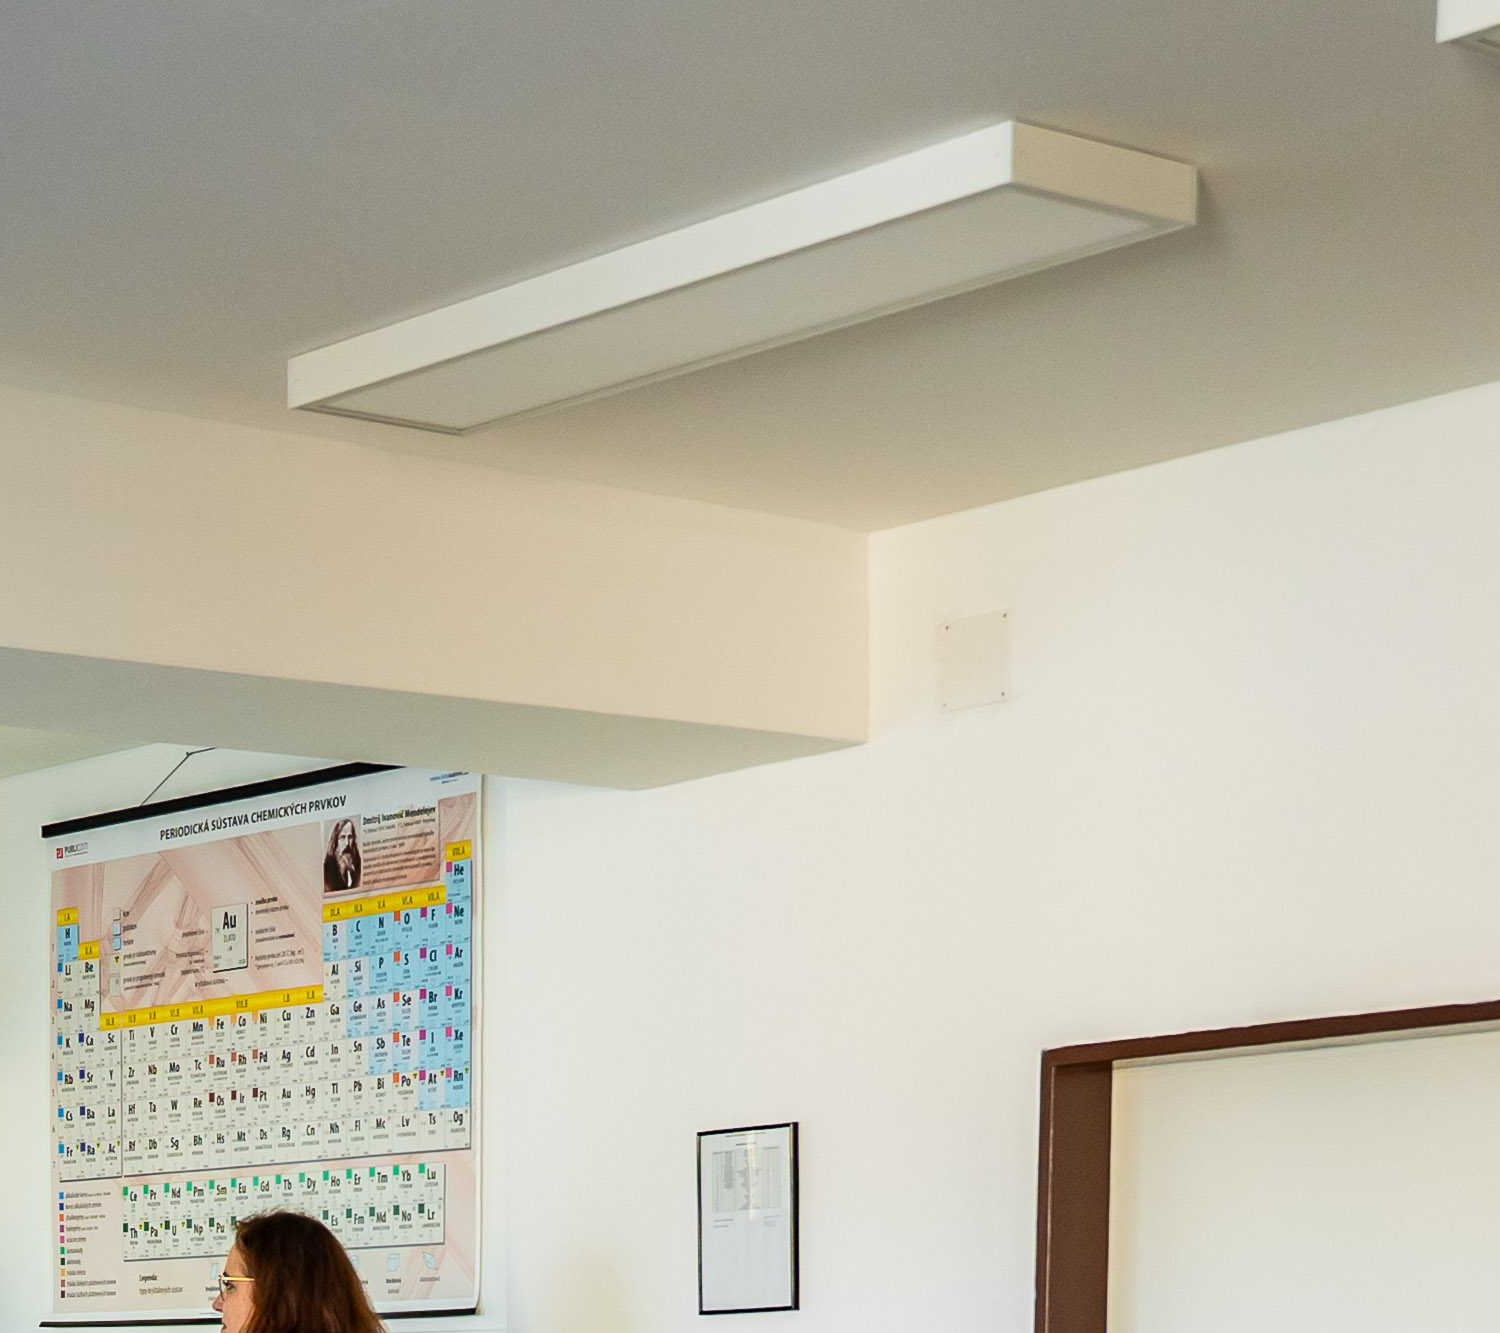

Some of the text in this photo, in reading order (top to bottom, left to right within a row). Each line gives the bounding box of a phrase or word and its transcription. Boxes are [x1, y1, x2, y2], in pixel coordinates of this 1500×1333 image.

[160, 795, 347, 840] PERIODICKÁ SÚSTAVA CHEMICKÝCH PRVKOV
[454, 864, 464, 876] He
[431, 909, 436, 921] F
[454, 905, 464, 917] Ne
[223, 912, 237, 929] Au
[378, 916, 384, 929] N
[404, 912, 410, 925] O
[332, 924, 338, 936] B
[356, 920, 361, 933] C
[65, 928, 71, 939] H
[430, 950, 437, 962] Cl
[454, 946, 463, 959] Ar
[379, 957, 384, 969] P
[404, 953, 409, 966] S
[65, 965, 71, 976] Li
[85, 962, 94, 973] Be
[331, 964, 339, 976] Al
[354, 960, 361, 973] Si
[428, 991, 438, 1003] Br
[454, 988, 463, 1000] Kr
[84, 999, 95, 1012] Mg
[376, 998, 386, 1009] As
[402, 994, 412, 1006] Se
[63, 1001, 73, 1012] Na
[330, 1004, 340, 1015] Ga
[353, 1001, 362, 1012] Ge
[260, 1013, 267, 1024] Ni
[282, 1010, 291, 1021] Cu
[305, 1007, 315, 1019] Zn
[192, 1022, 203, 1032] Mn
[216, 1018, 225, 1030] Fe
[238, 1016, 246, 1027] Co
[149, 1027, 155, 1038] V
[171, 1024, 178, 1035] Cr
[454, 1029, 463, 1041] Xe
[86, 1035, 94, 1046] Ca
[107, 1033, 115, 1044] Sc
[129, 1030, 135, 1041] Ti
[401, 1035, 410, 1046] Te
[65, 1037, 71, 1048] K
[353, 1040, 362, 1052] Sn
[376, 1038, 386, 1049] Sb
[305, 1046, 315, 1058] Cd
[331, 1044, 339, 1055] In
[259, 1051, 268, 1063] Pd
[281, 1050, 291, 1063] Ag
[169, 1062, 180, 1073] Mo
[194, 1059, 202, 1071] Tc
[216, 1057, 225, 1068] Ru
[109, 1069, 113, 1080] Y
[128, 1067, 135, 1078] Zr
[148, 1064, 157, 1075] Nb
[64, 1073, 74, 1085] Rb
[86, 1071, 94, 1083] Sr
[401, 1075, 411, 1087] Po
[428, 1073, 437, 1084] At
[454, 1070, 464, 1082] Rn
[331, 1083, 338, 1094] Tl
[353, 1080, 362, 1092] Pb
[377, 1078, 385, 1089] Bi
[259, 1090, 267, 1101] Pt
[281, 1088, 291, 1099] Au
[305, 1085, 315, 1099] Hg
[171, 1100, 178, 1110] W
[216, 1095, 225, 1106] Os
[107, 1107, 115, 1117] La
[149, 1102, 157, 1113] Ta
[65, 1110, 73, 1121] Cs
[86, 1108, 95, 1119] Ba
[428, 1113, 437, 1125] Ts
[453, 1111, 463, 1125] Og
[354, 1120, 361, 1132] Fl
[376, 1118, 386, 1129] Mc
[401, 1116, 410, 1127] Lv
[306, 1125, 315, 1136] Cn
[170, 1137, 179, 1150] Sg
[66, 1146, 74, 1157] Fr
[87, 1145, 95, 1156] Ra
[354, 1174, 361, 1185] Er
[377, 1172, 388, 1183] Tm
[401, 1170, 411, 1181] Yb
[427, 1169, 436, 1180] Lu
[260, 1181, 270, 1192] Gd
[283, 1179, 292, 1191] Tb
[306, 1178, 316, 1191] Dy
[331, 1176, 340, 1187] Ho
[130, 1191, 137, 1202] Ce
[150, 1189, 157, 1200] Pr
[171, 1187, 181, 1199] Nd
[354, 1214, 364, 1224] Fm
[402, 1210, 411, 1221] No
[427, 1209, 435, 1220] Lr
[331, 1215, 338, 1226] Es
[130, 1227, 138, 1239] Th
[151, 1226, 158, 1237] Pa
[172, 1225, 177, 1236] U
[193, 1224, 204, 1236] Np
[216, 1222, 225, 1233] Pu
